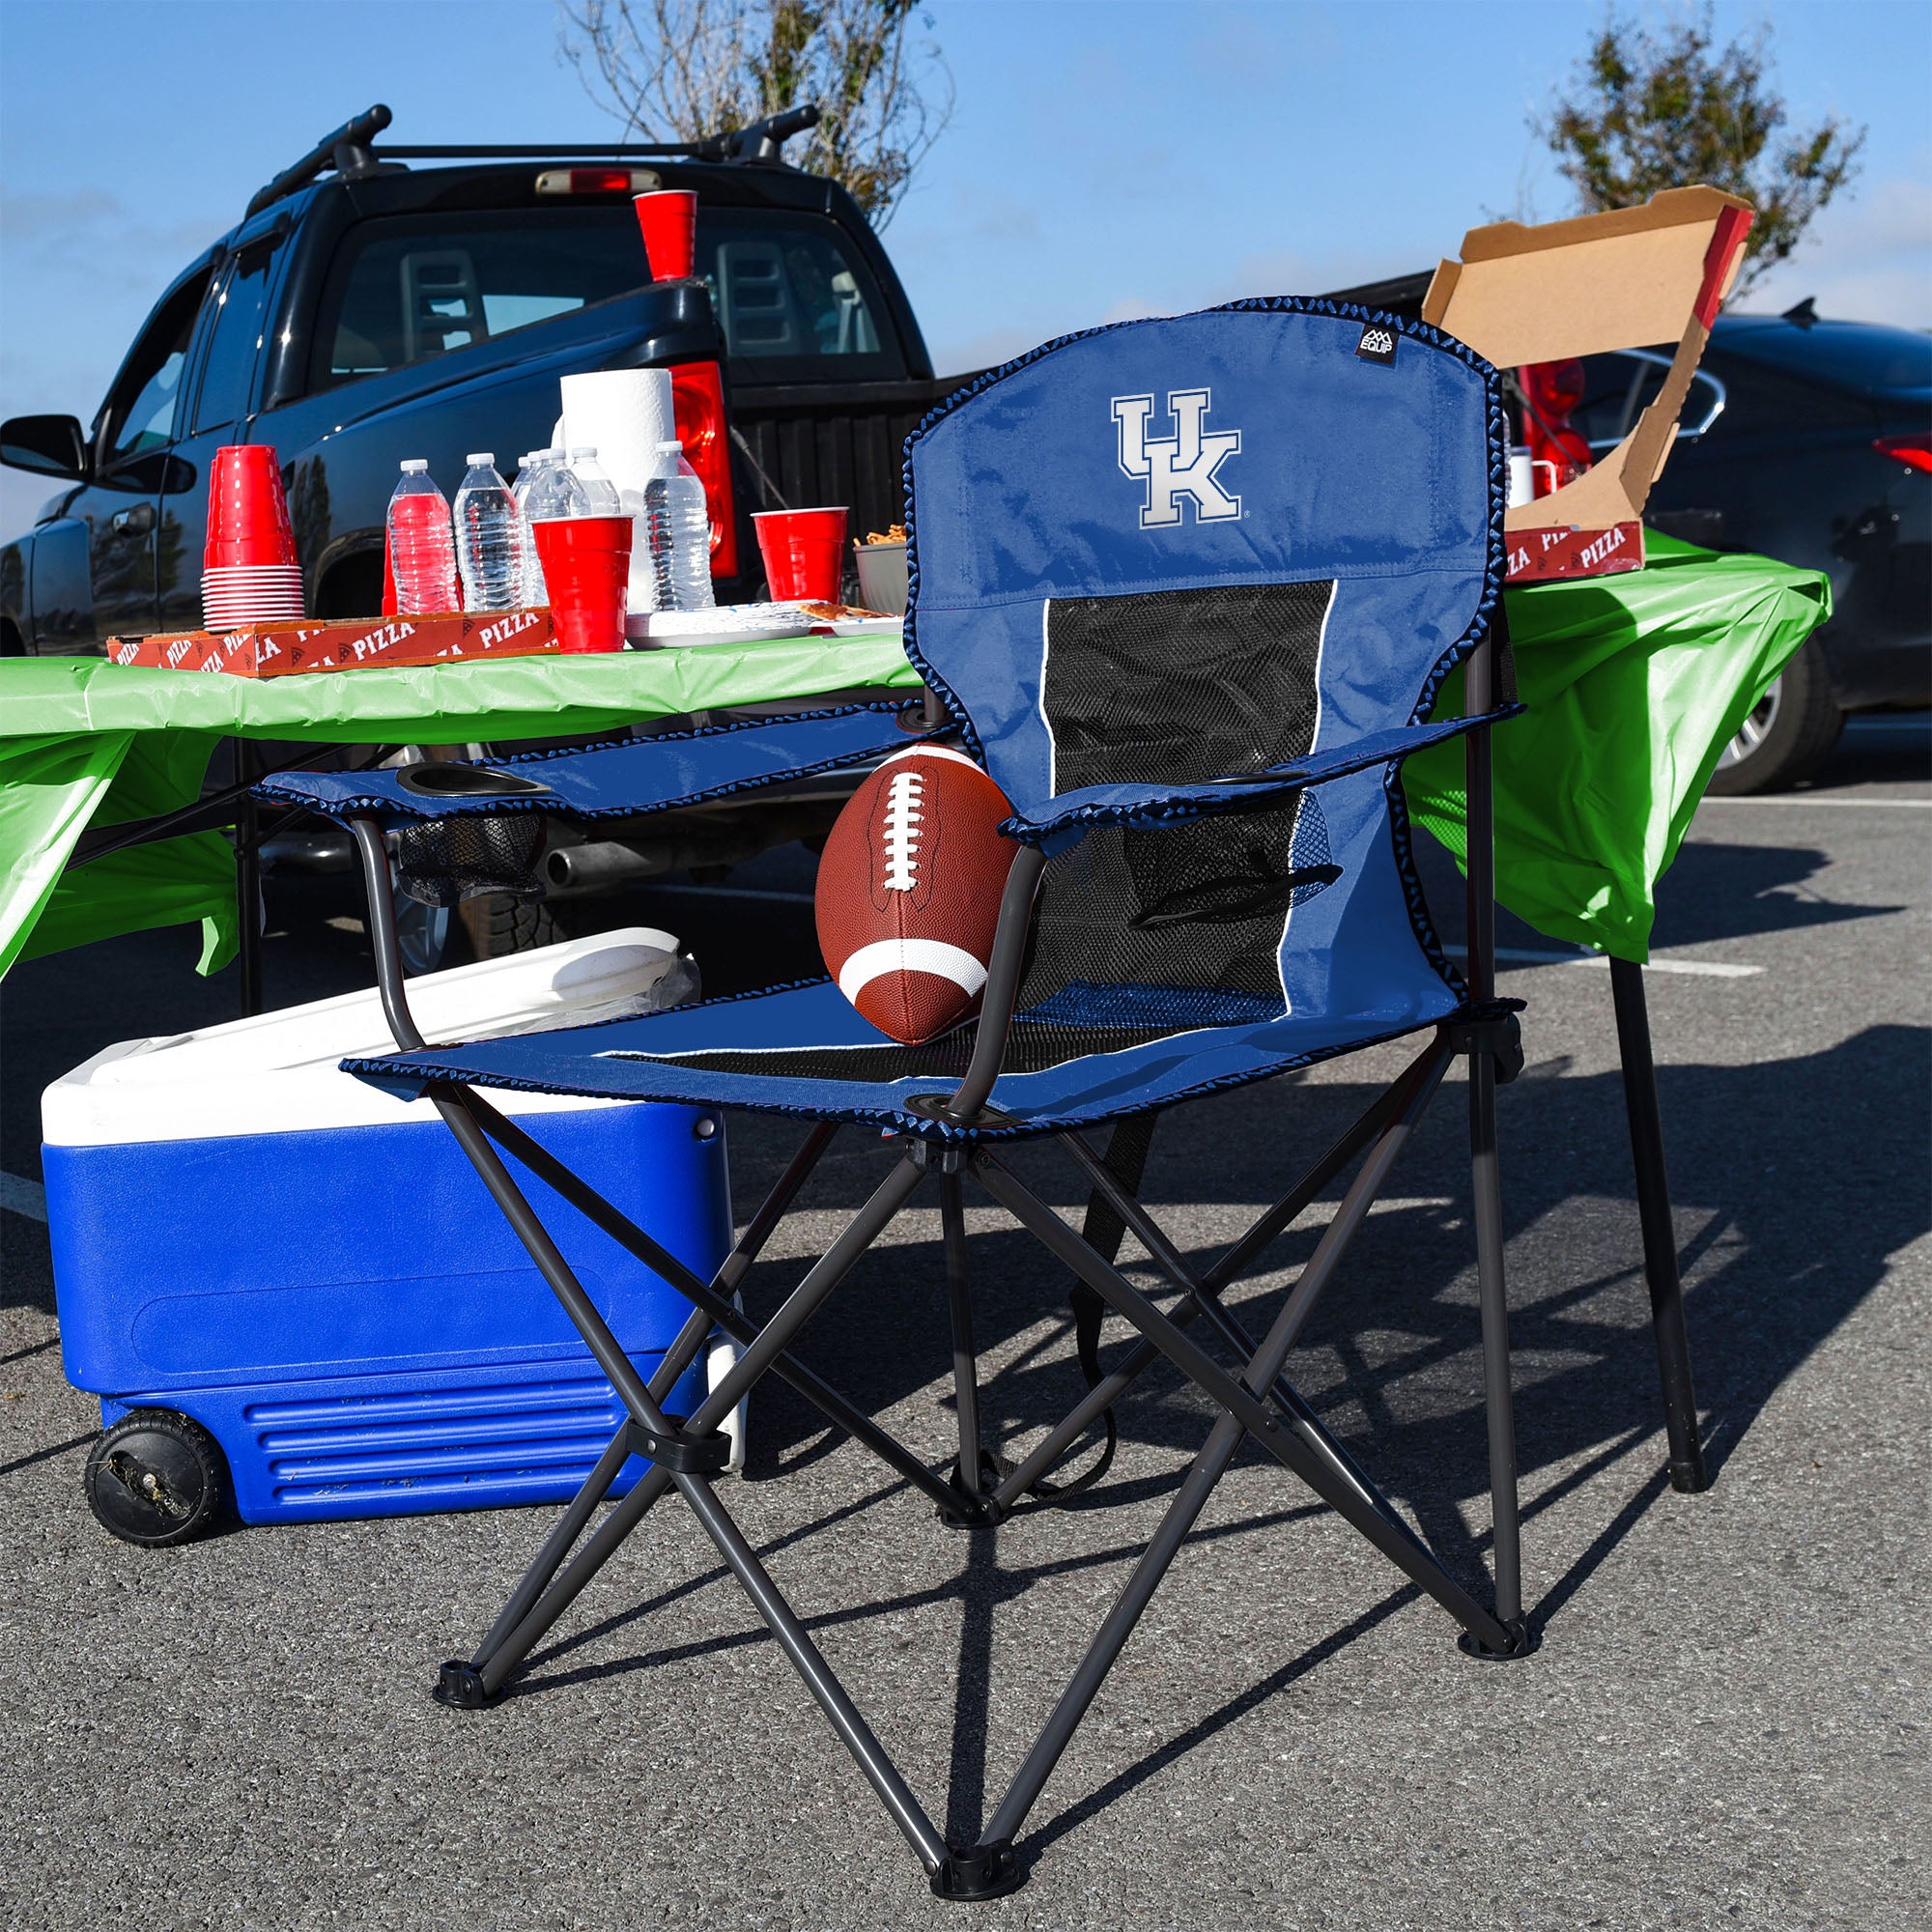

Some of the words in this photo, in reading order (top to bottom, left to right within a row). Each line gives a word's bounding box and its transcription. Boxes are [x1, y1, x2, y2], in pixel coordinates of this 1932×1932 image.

[1360, 338, 1393, 355] EQUIP
[1111, 387, 1241, 530] UK
[1580, 527, 1627, 568] PIZZA
[352, 622, 416, 661] PIZZA
[479, 612, 540, 649] PIZZA
[116, 643, 140, 666] PIZZA
[166, 639, 192, 670] PIZZA
